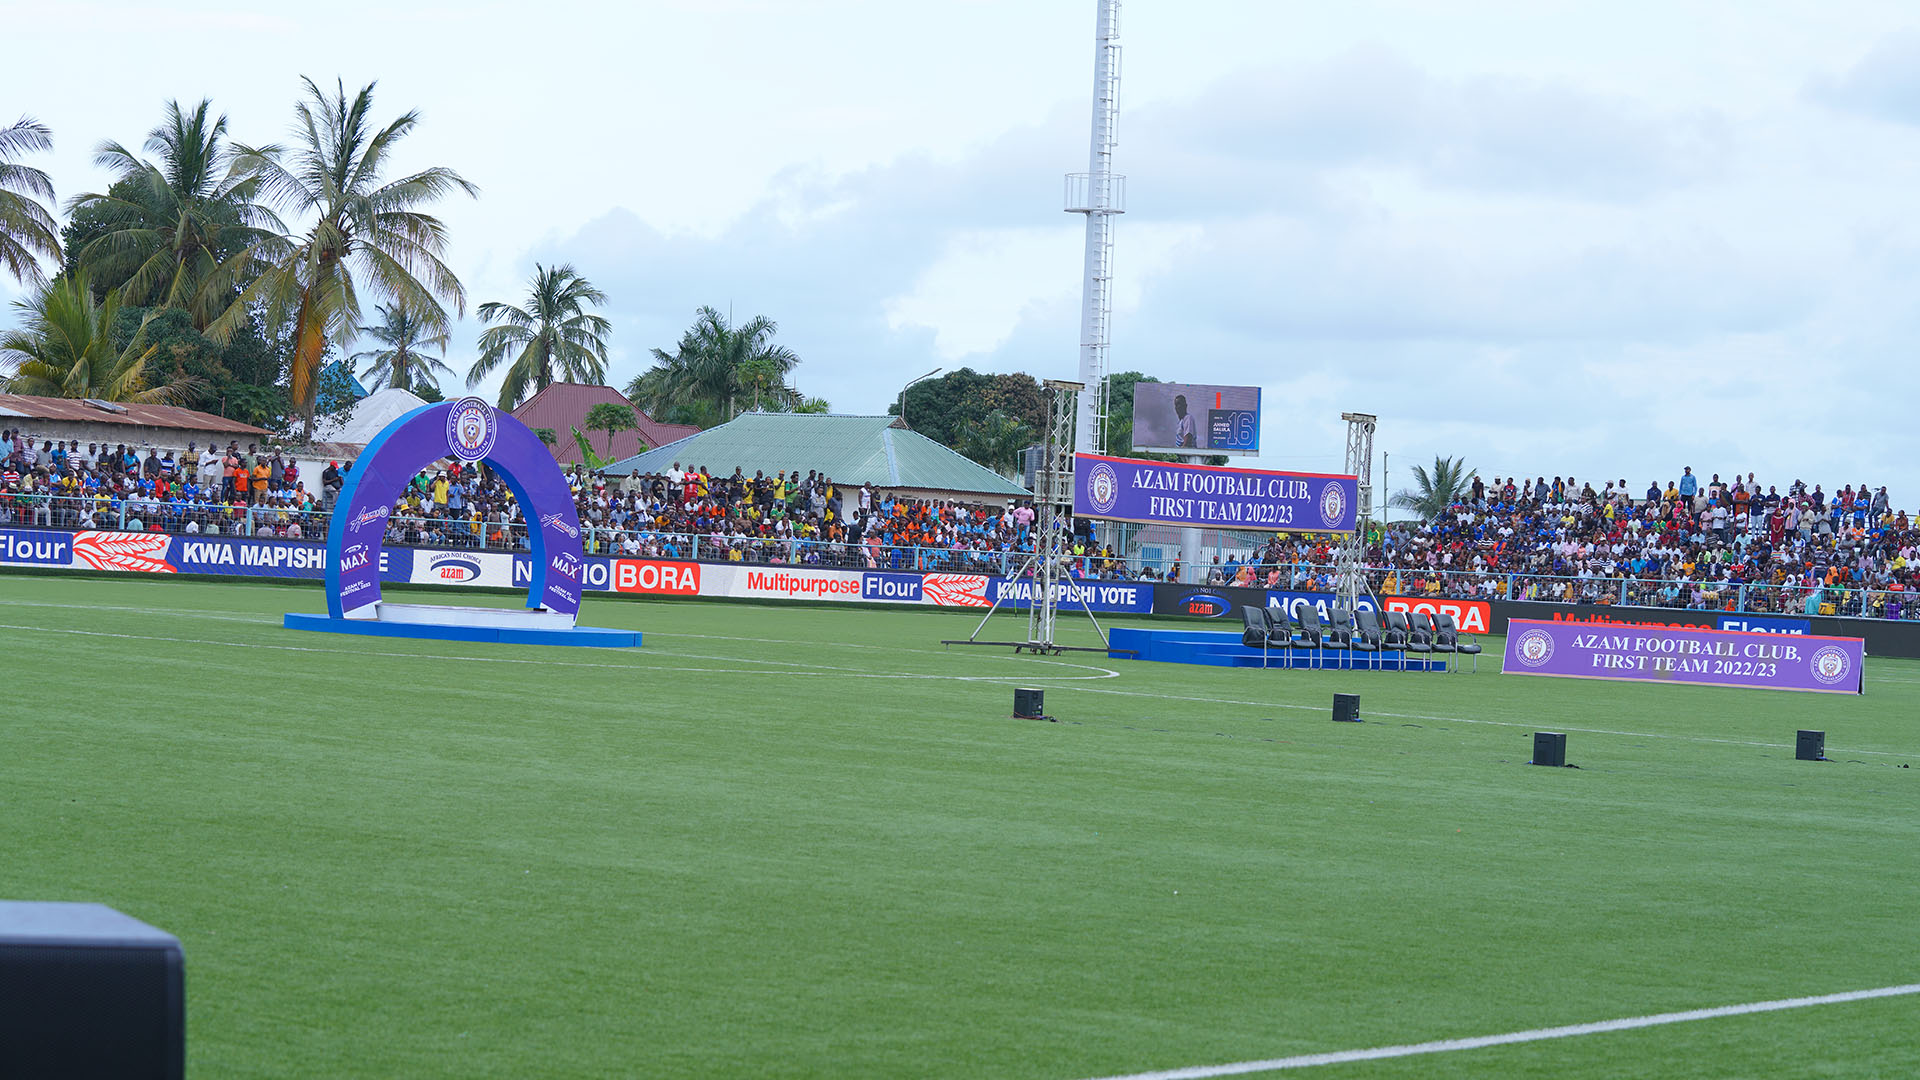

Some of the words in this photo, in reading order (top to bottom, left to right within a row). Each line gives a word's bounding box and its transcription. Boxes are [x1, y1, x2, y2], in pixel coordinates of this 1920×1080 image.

[1227, 412, 1254, 445] 16
[1132, 469, 1180, 491] AZAM
[1183, 473, 1265, 497] FOOTBALL
[1268, 479, 1311, 503] CLUB,
[1149, 496, 1195, 518] FIRST
[1197, 500, 1243, 521] TEAM
[1245, 503, 1293, 524] 2022/23
[183, 542, 235, 565] KWA
[440, 566, 463, 579] azam
[619, 564, 697, 590] BORA
[747, 572, 860, 596] Multipurpose
[866, 577, 918, 597] Flour
[1099, 586, 1137, 605] YOTE
[1189, 602, 1213, 615] azam
[1571, 634, 1630, 650] AZAM
[1633, 637, 1740, 656] FOOTBALL
[1743, 643, 1802, 663] CLUB,
[1592, 653, 1648, 670] FIRST
[1652, 656, 1709, 674] TEAM
[1713, 660, 1777, 677] 2022/23
